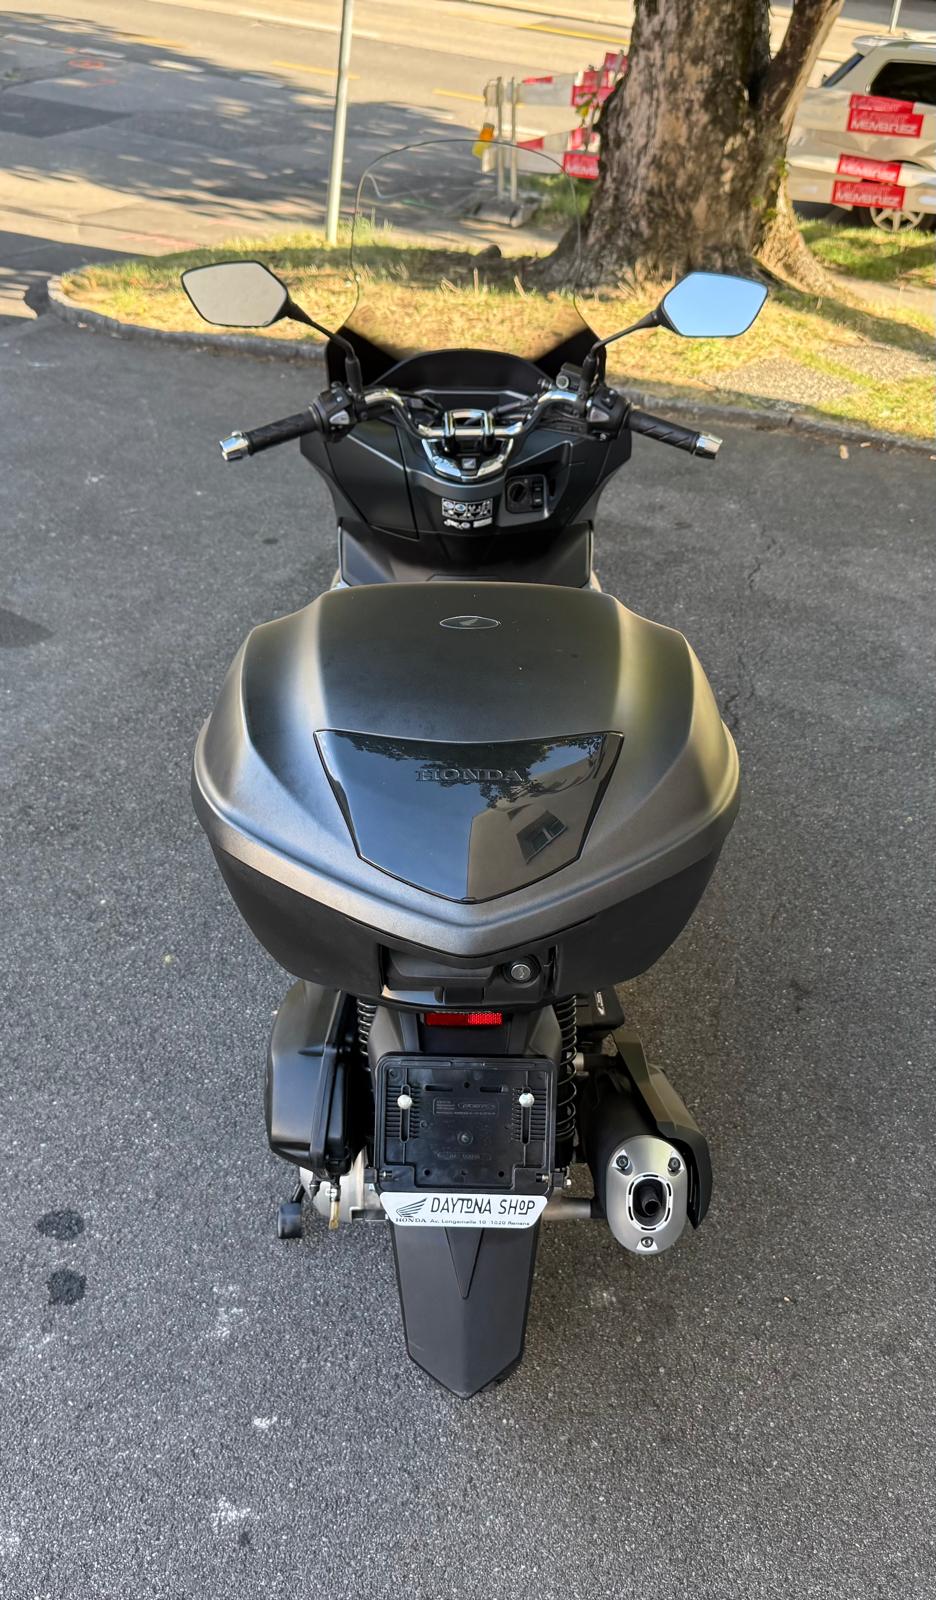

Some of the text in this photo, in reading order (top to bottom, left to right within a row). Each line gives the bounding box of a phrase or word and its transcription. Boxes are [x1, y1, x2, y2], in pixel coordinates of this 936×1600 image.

[416, 768, 525, 782] HONDA
[430, 1197, 536, 1216] DAYTONA SHOP
